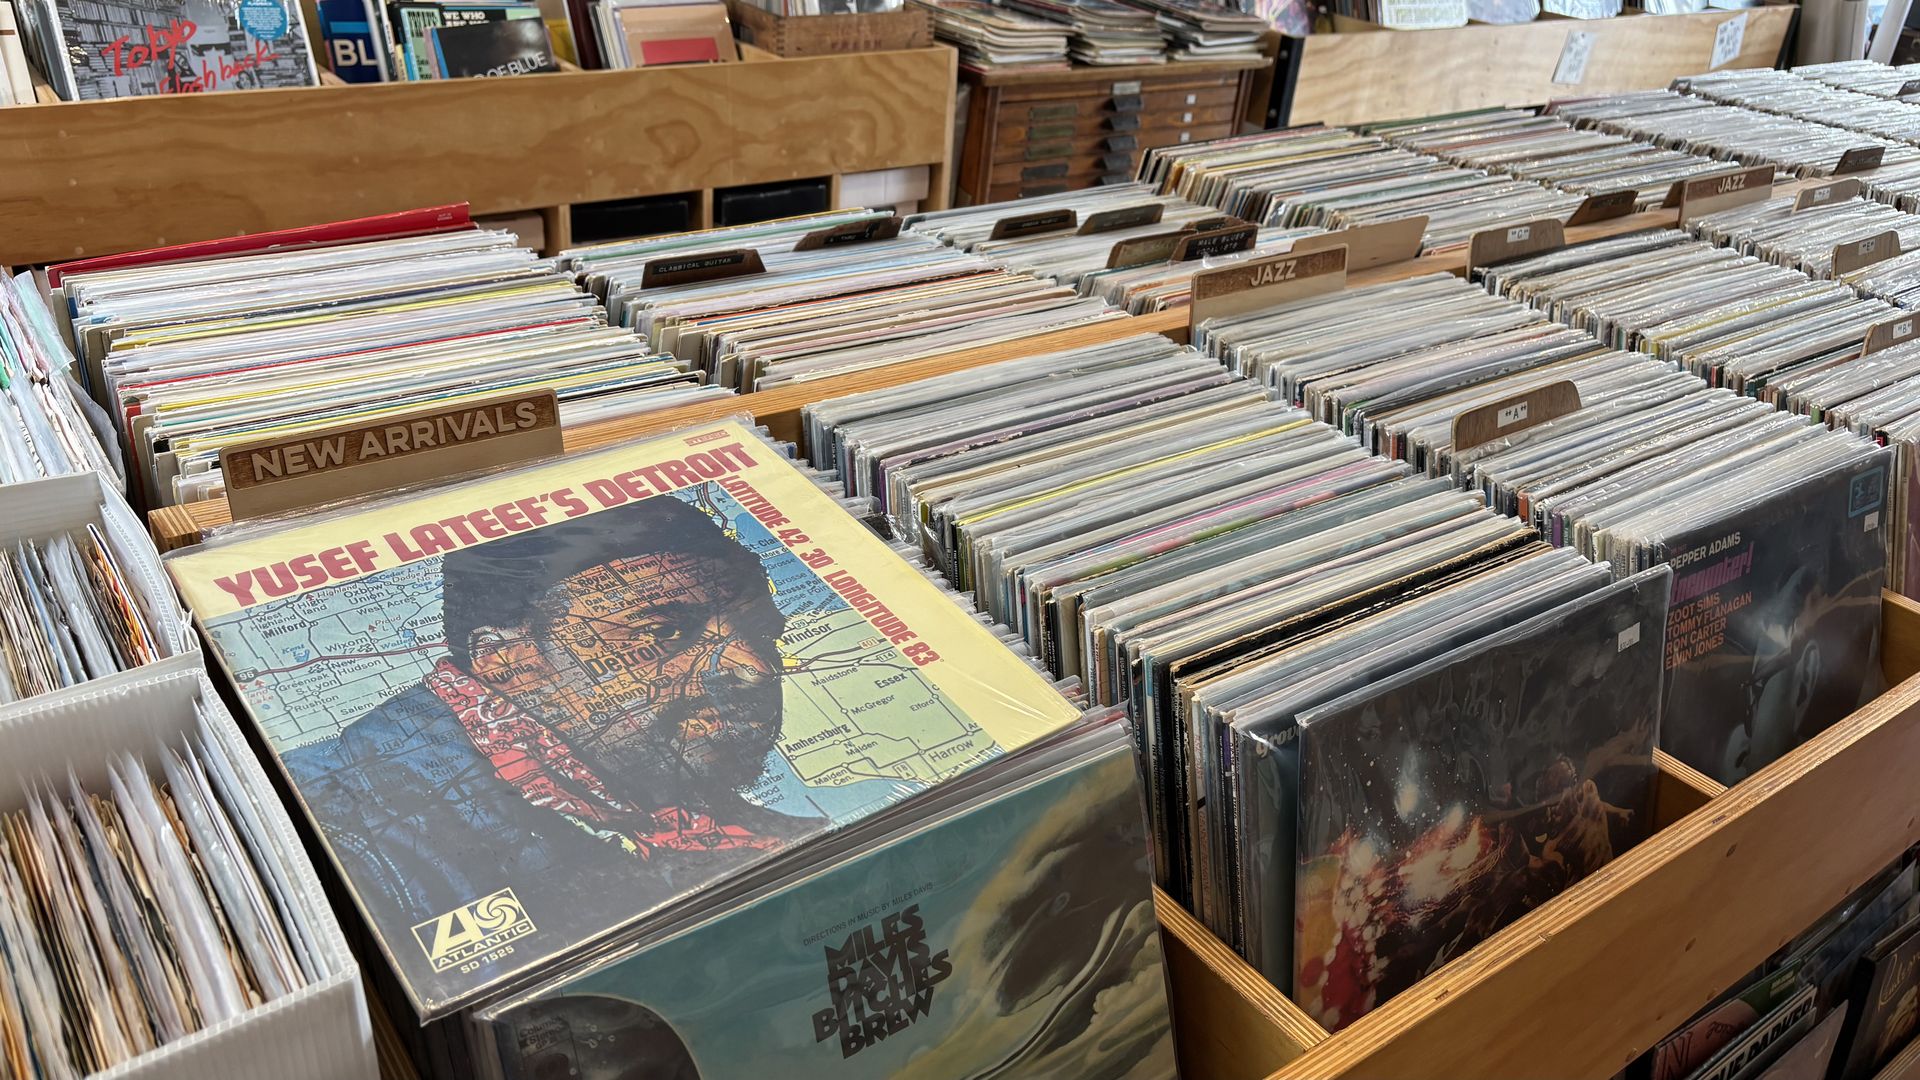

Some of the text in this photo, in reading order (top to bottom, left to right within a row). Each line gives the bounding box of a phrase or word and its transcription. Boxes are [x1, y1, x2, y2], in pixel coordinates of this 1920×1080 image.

[333, 38, 377, 67] BL
[1718, 173, 1747, 193] JAZZ
[658, 258, 732, 272] CLASSICAL GUITAR
[1250, 259, 1297, 287] JAZZ
[250, 400, 537, 481] NEW ARRIVALS
[214, 442, 759, 608] YUSEF LATEEF'S DETROIT
[761, 549, 779, 559] More
[1670, 545, 1707, 570] PEPPER
[1708, 531, 1741, 556] ADAMS
[617, 560, 658, 575] Warren
[718, 475, 791, 529] LATITUDE
[823, 569, 918, 646] LONGITUDE
[766, 559, 795, 570] Grosse
[392, 571, 420, 582] Dodge
[576, 572, 611, 588] Royal
[774, 572, 807, 586] Grosse
[317, 584, 358, 598] Highland
[343, 584, 383, 598] Oxbow
[348, 592, 384, 605] Union
[777, 583, 806, 597] Grosse
[303, 604, 327, 615] land
[387, 596, 416, 608] Acres
[1668, 592, 1720, 625] ZOOT SIMS
[250, 614, 297, 631] Highland
[256, 612, 282, 623] West
[375, 615, 402, 626] Proud
[407, 612, 444, 628] Walled
[1667, 592, 1752, 640] TOMMY FLANAGAN
[263, 621, 307, 639] Milford
[782, 623, 832, 646] Windsor
[1665, 634, 1687, 655] RON
[1690, 618, 1727, 643] CARTER
[325, 636, 367, 652] Wixom
[862, 639, 877, 647] 401
[1694, 633, 1725, 657] JONES
[331, 659, 356, 669] New
[337, 659, 381, 677] Hudson
[584, 643, 667, 677] Detroi
[482, 663, 534, 682] Livonia
[811, 667, 858, 687] Maidstone
[874, 673, 908, 688] Essex
[279, 672, 330, 692] Greenoak
[294, 695, 339, 712] Rushton
[584, 686, 647, 712] Dearborn
[851, 694, 895, 715] McGregor
[340, 702, 375, 716] Salem
[296, 732, 339, 748] Worden
[784, 723, 851, 753] Amherstburg
[846, 740, 879, 756] Malden
[928, 740, 974, 762] Harrow
[813, 769, 847, 786] Malden
[803, 921, 848, 947] DIRECTIONS
[847, 917, 856, 926] IN
[856, 906, 881, 922] MUSIC
[881, 902, 891, 911] BY
[892, 892, 913, 906] MILES
[824, 903, 924, 963] MILES
[438, 922, 531, 968] ATLANTIC
[460, 945, 515, 974] SD 1525
[839, 986, 935, 1059] BREW
